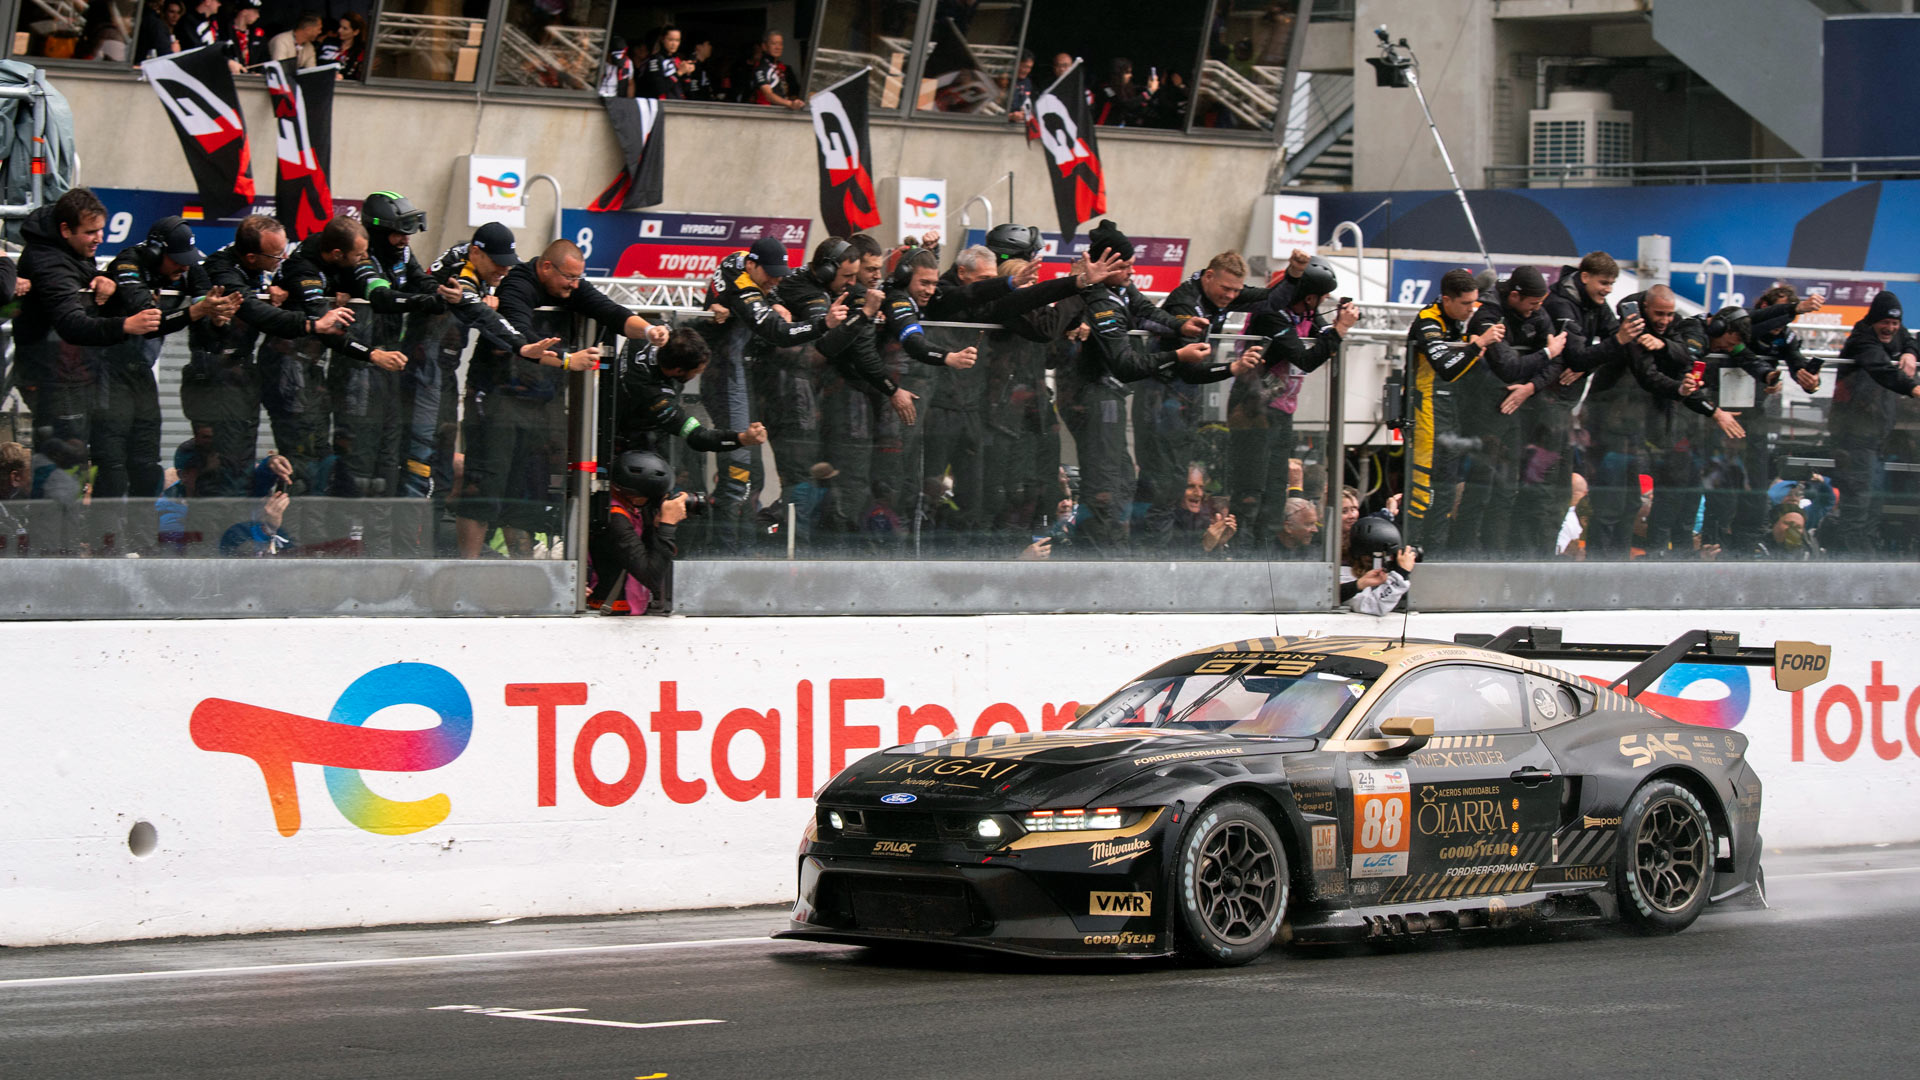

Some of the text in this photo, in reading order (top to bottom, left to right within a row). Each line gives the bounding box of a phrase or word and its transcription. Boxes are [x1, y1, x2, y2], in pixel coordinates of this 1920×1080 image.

[680, 224, 727, 235] HYPERCAR
[576, 227, 593, 260] 8
[658, 254, 717, 271] TOYOTA
[1399, 279, 1431, 304] 87
[1214, 653, 1327, 661] MUSTANG
[1780, 654, 1826, 671] FORD
[1194, 659, 1318, 675] GT3
[1619, 733, 1693, 768] SAS
[878, 758, 1018, 779] IKIGAI
[1438, 786, 1500, 797] ACEROS INOXIDABLES
[1361, 797, 1403, 849] 88
[1417, 800, 1508, 838] OLARRA
[1316, 829, 1331, 846] LM
[873, 842, 917, 853] STALOC
[1089, 838, 1151, 861] Milwaukee
[1440, 841, 1509, 859] GOODYEAR
[1315, 848, 1333, 866] GT3
[1564, 866, 1608, 880] KIRKA
[1096, 895, 1144, 912] VMR
[1084, 931, 1156, 945] GOODYEAR
